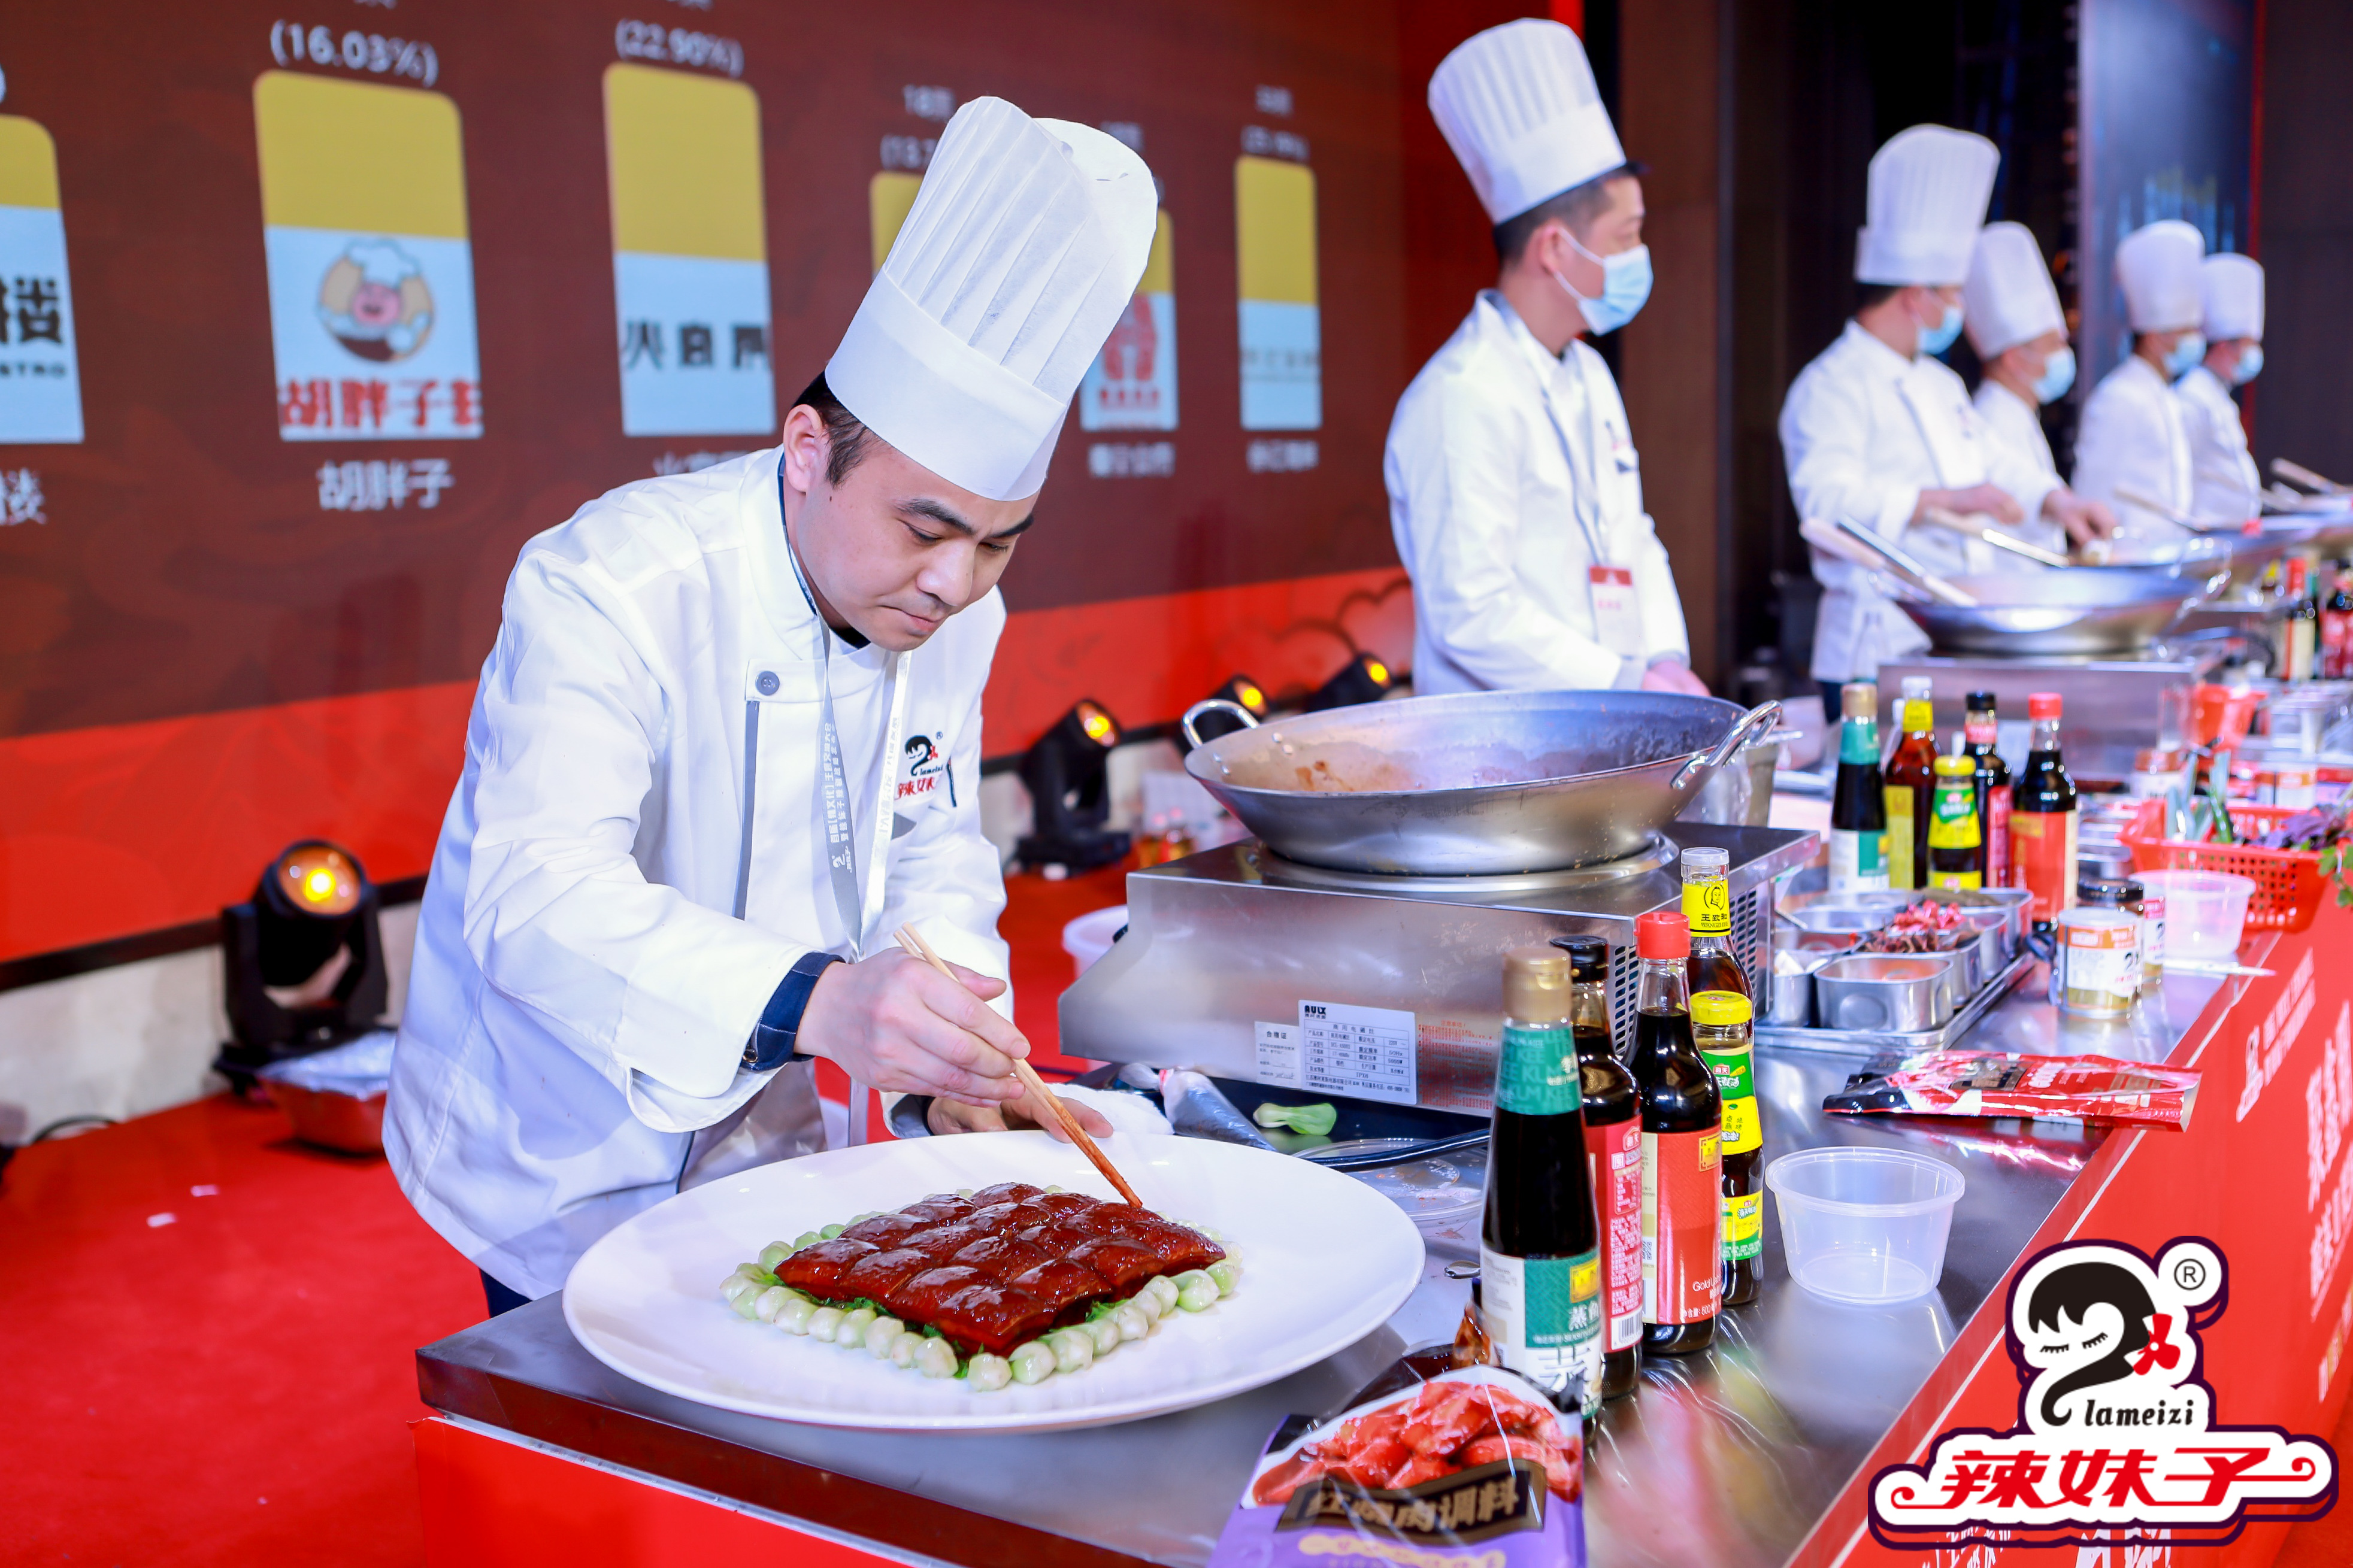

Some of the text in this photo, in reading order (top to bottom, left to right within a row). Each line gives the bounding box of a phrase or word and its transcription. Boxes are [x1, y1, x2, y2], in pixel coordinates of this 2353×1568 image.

[269, 20, 438, 87] (16.03%)
[317, 459, 453, 510] 胡胖子
[1700, 913, 1728, 921] 王致和
[1267, 1030, 1287, 1039] 合格证
[1692, 1279, 1710, 1291] Gold
